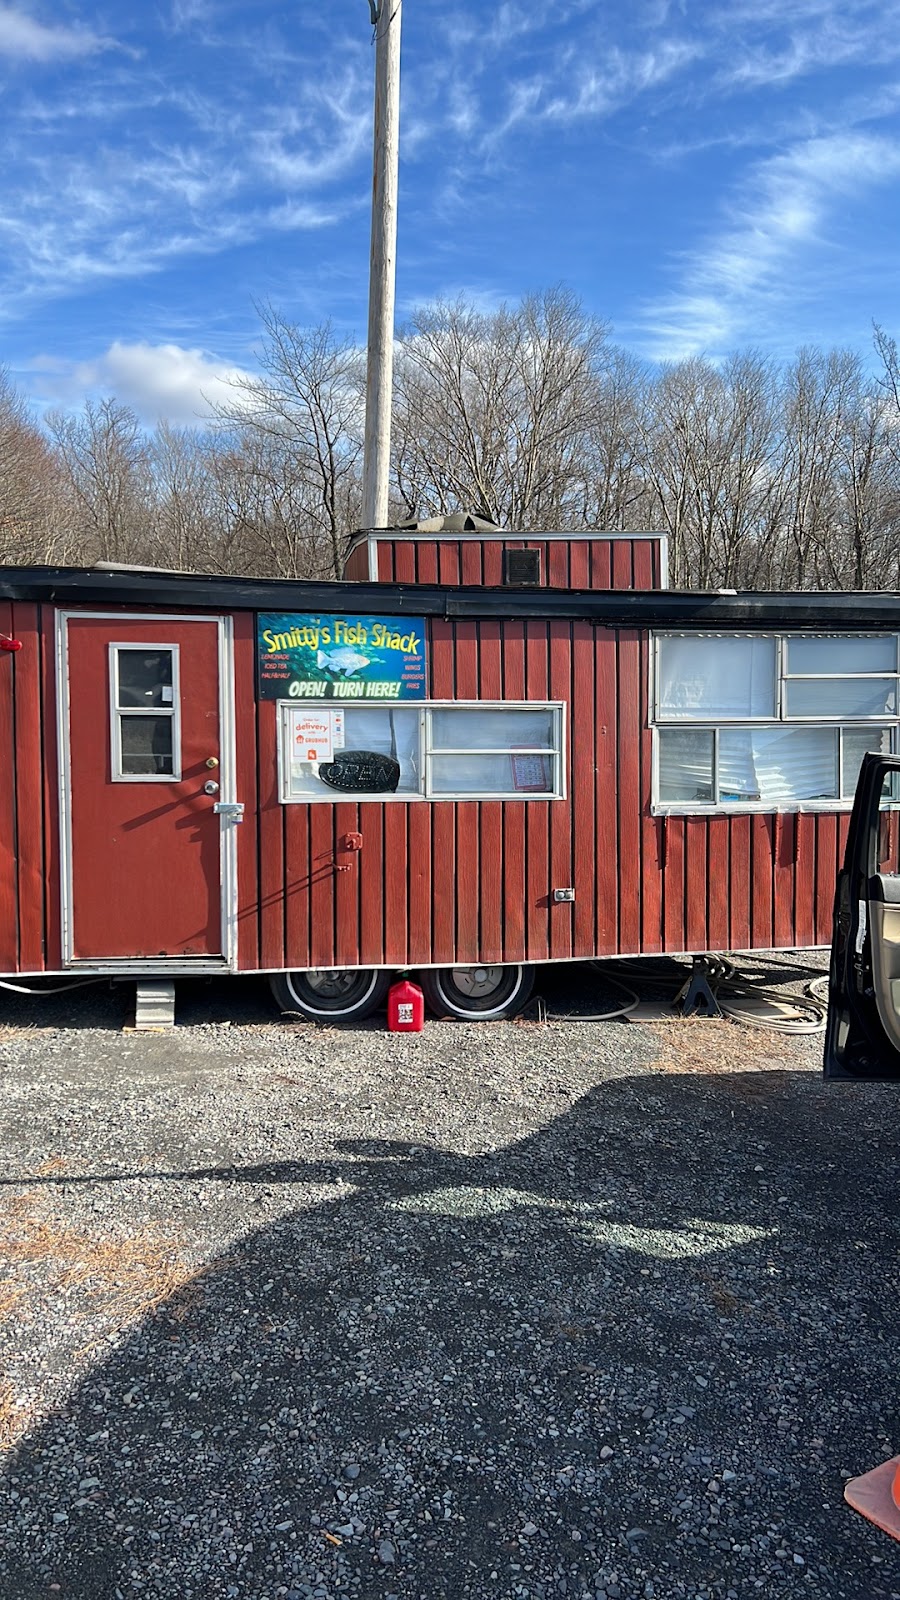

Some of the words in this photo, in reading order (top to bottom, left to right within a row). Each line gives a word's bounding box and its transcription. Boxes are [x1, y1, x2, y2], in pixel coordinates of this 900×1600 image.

[263, 618, 331, 653] Smitty's
[335, 621, 367, 645] Fish
[371, 623, 421, 655] Shack
[288, 680, 328, 697] OPEN!
[332, 681, 365, 698] TURN
[366, 681, 402, 698] HERE!
[296, 722, 328, 732] delivery
[327, 763, 395, 781] OPEN
